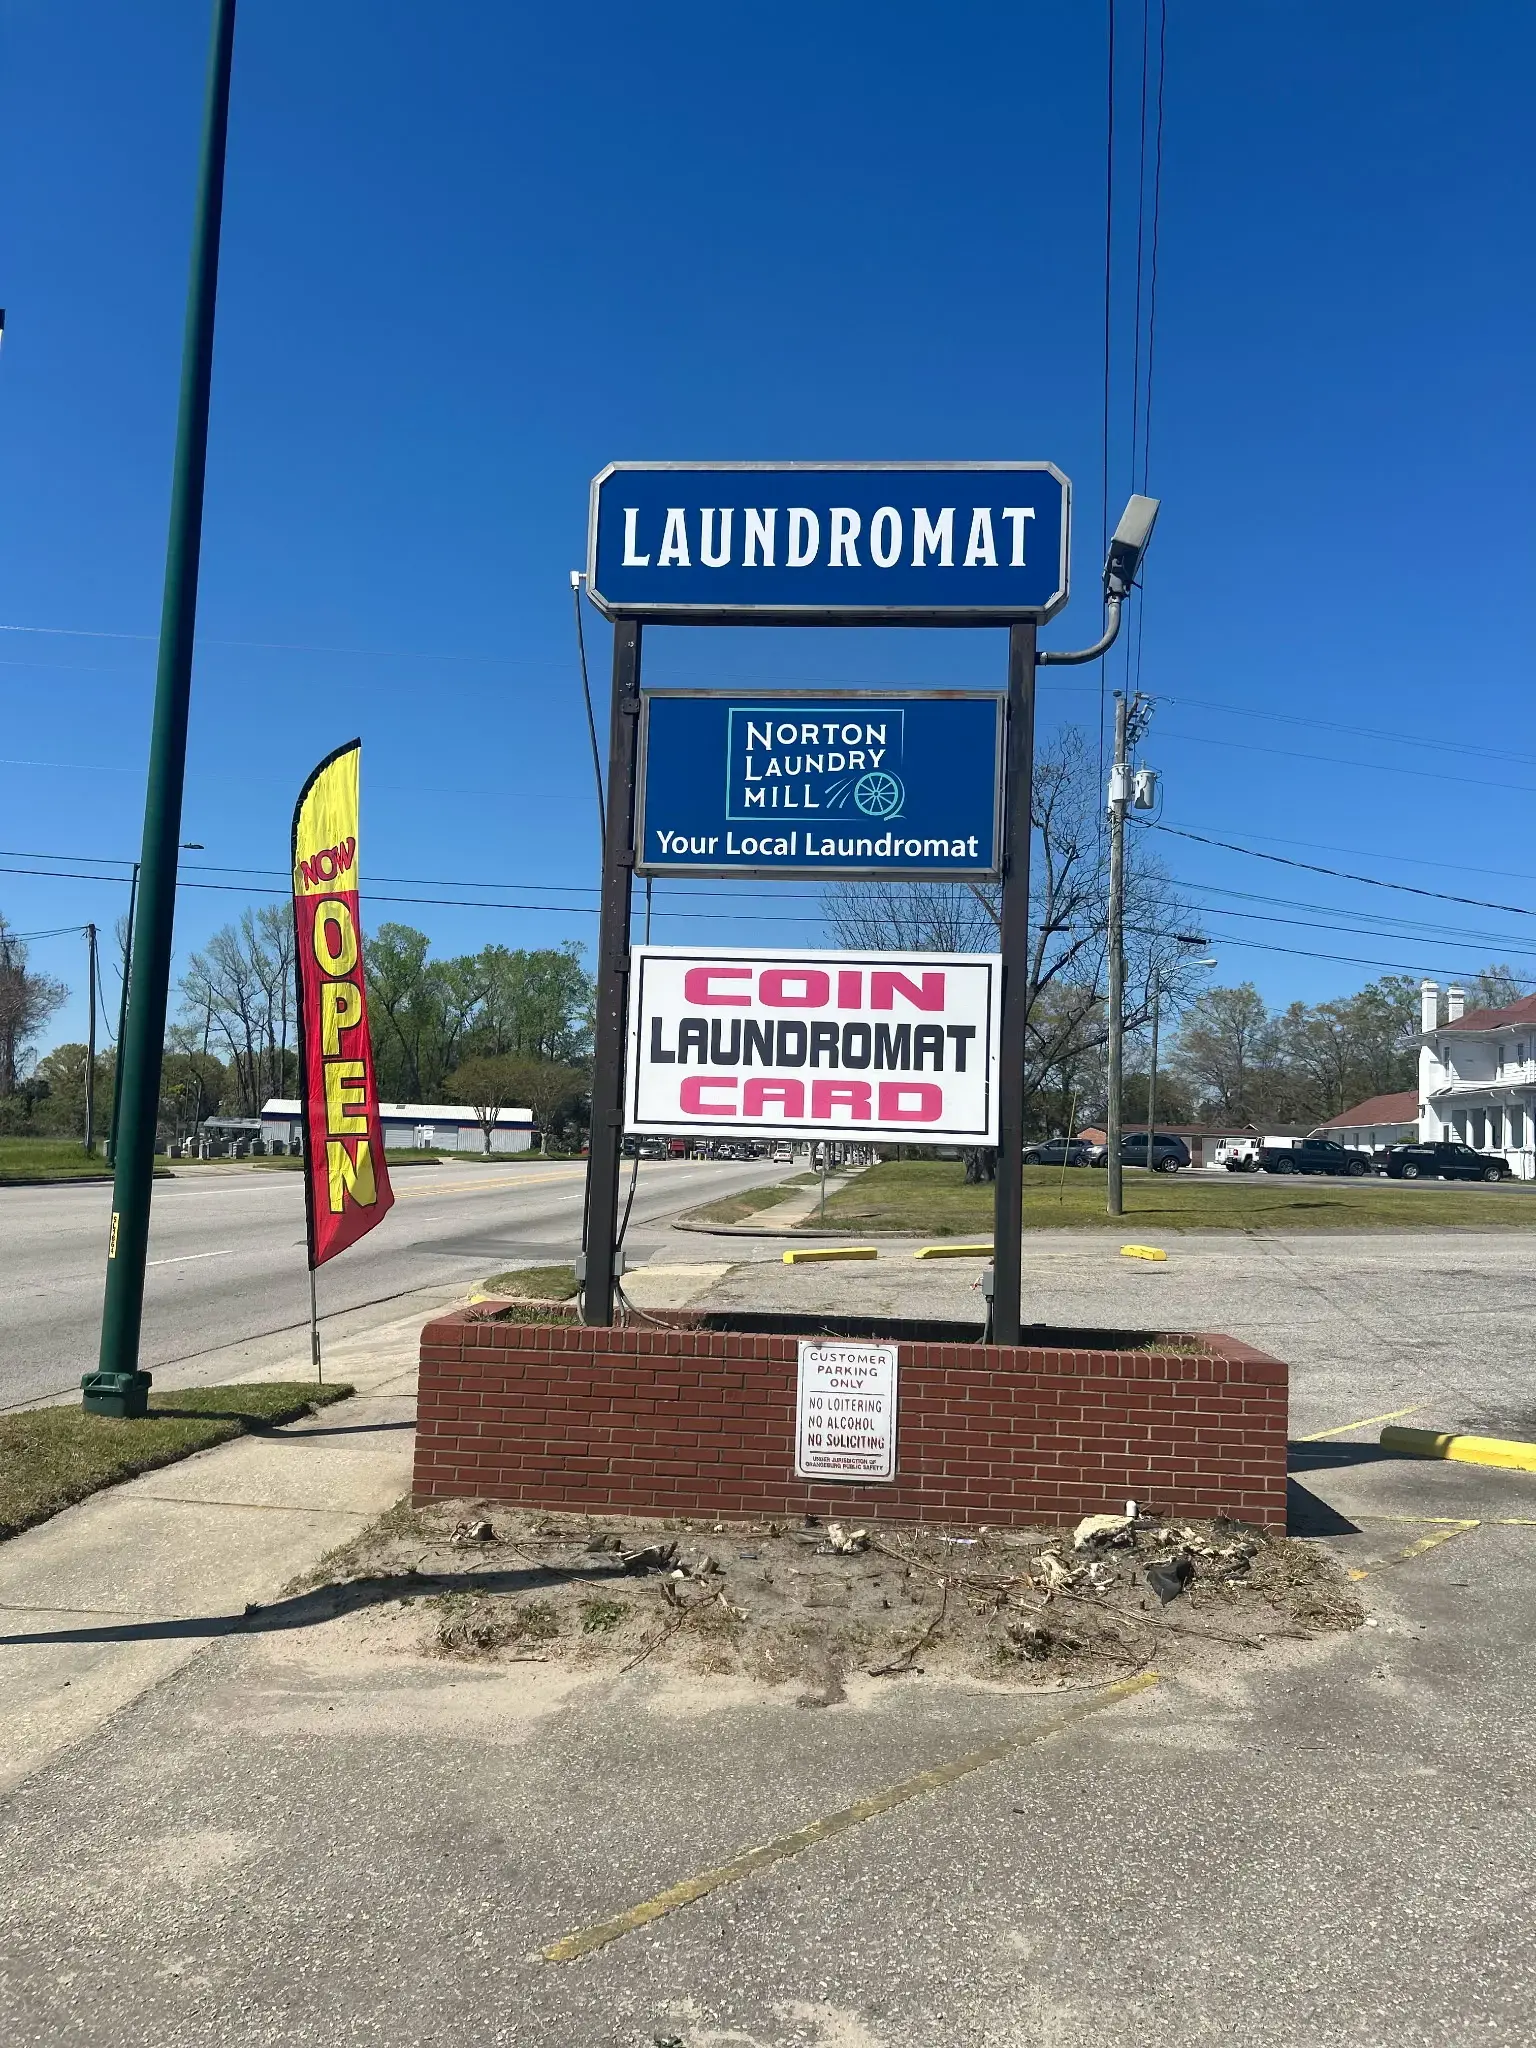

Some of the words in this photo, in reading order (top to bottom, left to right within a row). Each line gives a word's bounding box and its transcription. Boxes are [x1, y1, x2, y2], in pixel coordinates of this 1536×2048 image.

[621, 506, 1036, 569] LAUNDROMAT
[745, 721, 887, 751] NORTON
[745, 749, 886, 782] LAUNDRY
[744, 784, 820, 809] MILL
[656, 830, 719, 855] Your
[726, 831, 797, 857] Local
[805, 832, 979, 858] Laundromat
[300, 836, 356, 891] NOW
[684, 967, 946, 1012] COIN
[313, 897, 377, 1215] OPEN
[650, 1016, 977, 1073] LAUNDROMAT
[679, 1075, 943, 1122] CARD
[810, 1352, 886, 1365] CUSTOMER
[817, 1365, 878, 1377] PARKING
[830, 1378, 864, 1389] ONLY
[809, 1397, 823, 1410] NO
[827, 1397, 882, 1413] LOITERING
[808, 1416, 823, 1428] NO
[827, 1416, 875, 1431] ALCOHOL
[808, 1433, 822, 1446] NO
[826, 1434, 885, 1450] SOLICITING
